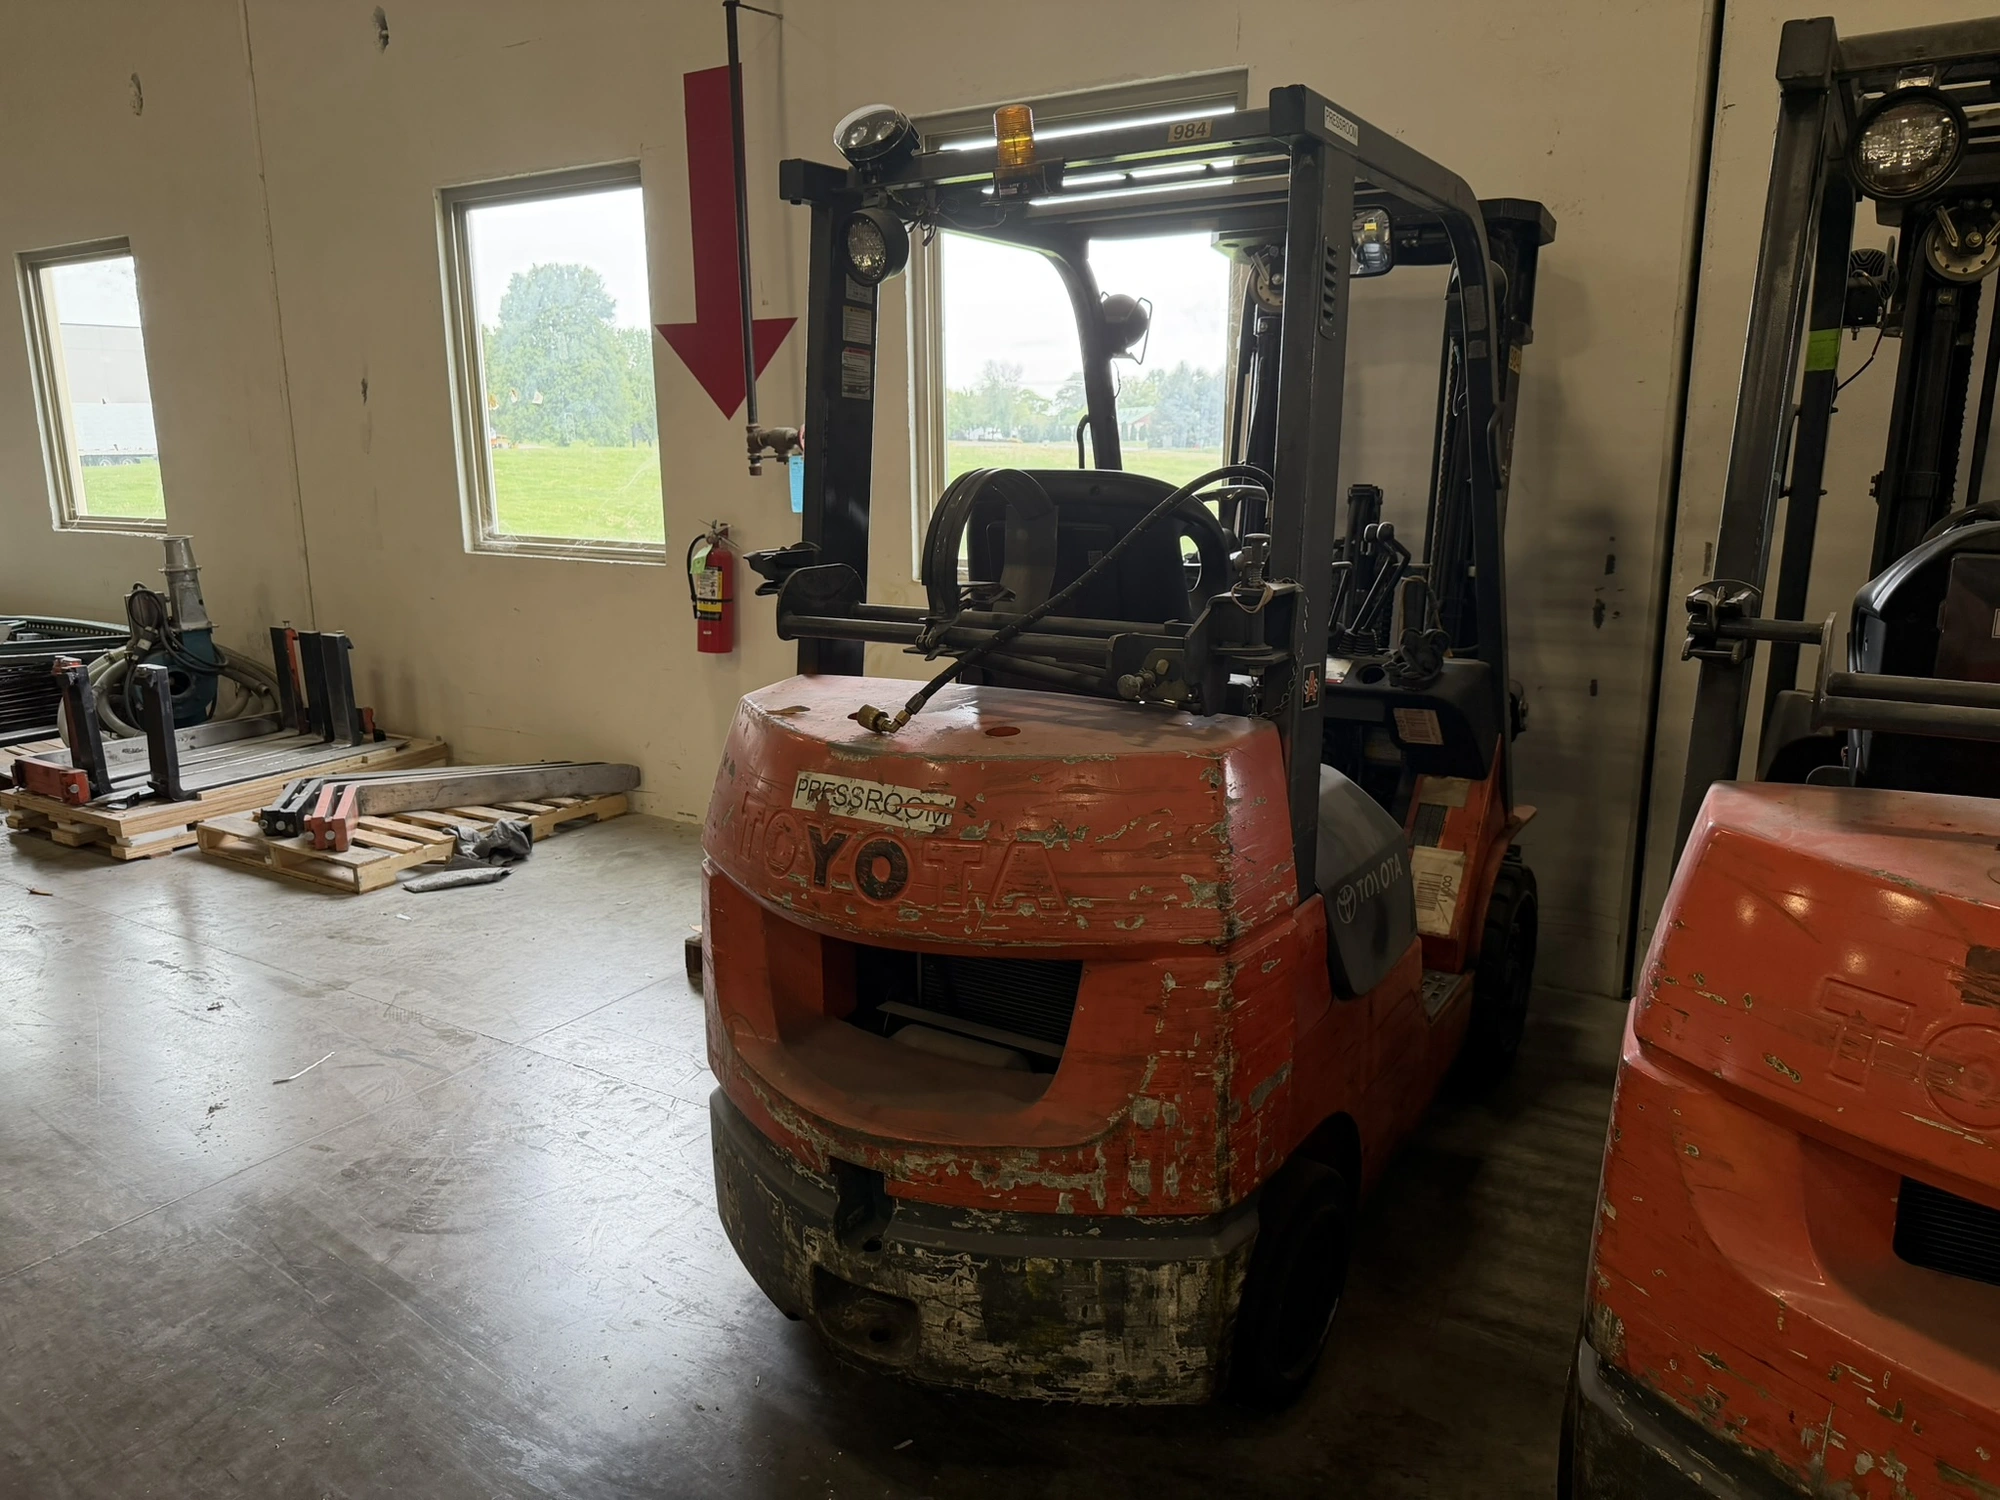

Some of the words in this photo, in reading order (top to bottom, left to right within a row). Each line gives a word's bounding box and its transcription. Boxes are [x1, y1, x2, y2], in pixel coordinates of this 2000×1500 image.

[1173, 122, 1206, 140] 984
[1326, 109, 1356, 139] PRESSROOM
[1303, 670, 1319, 703] SAS
[739, 791, 1070, 915] TOYOTA
